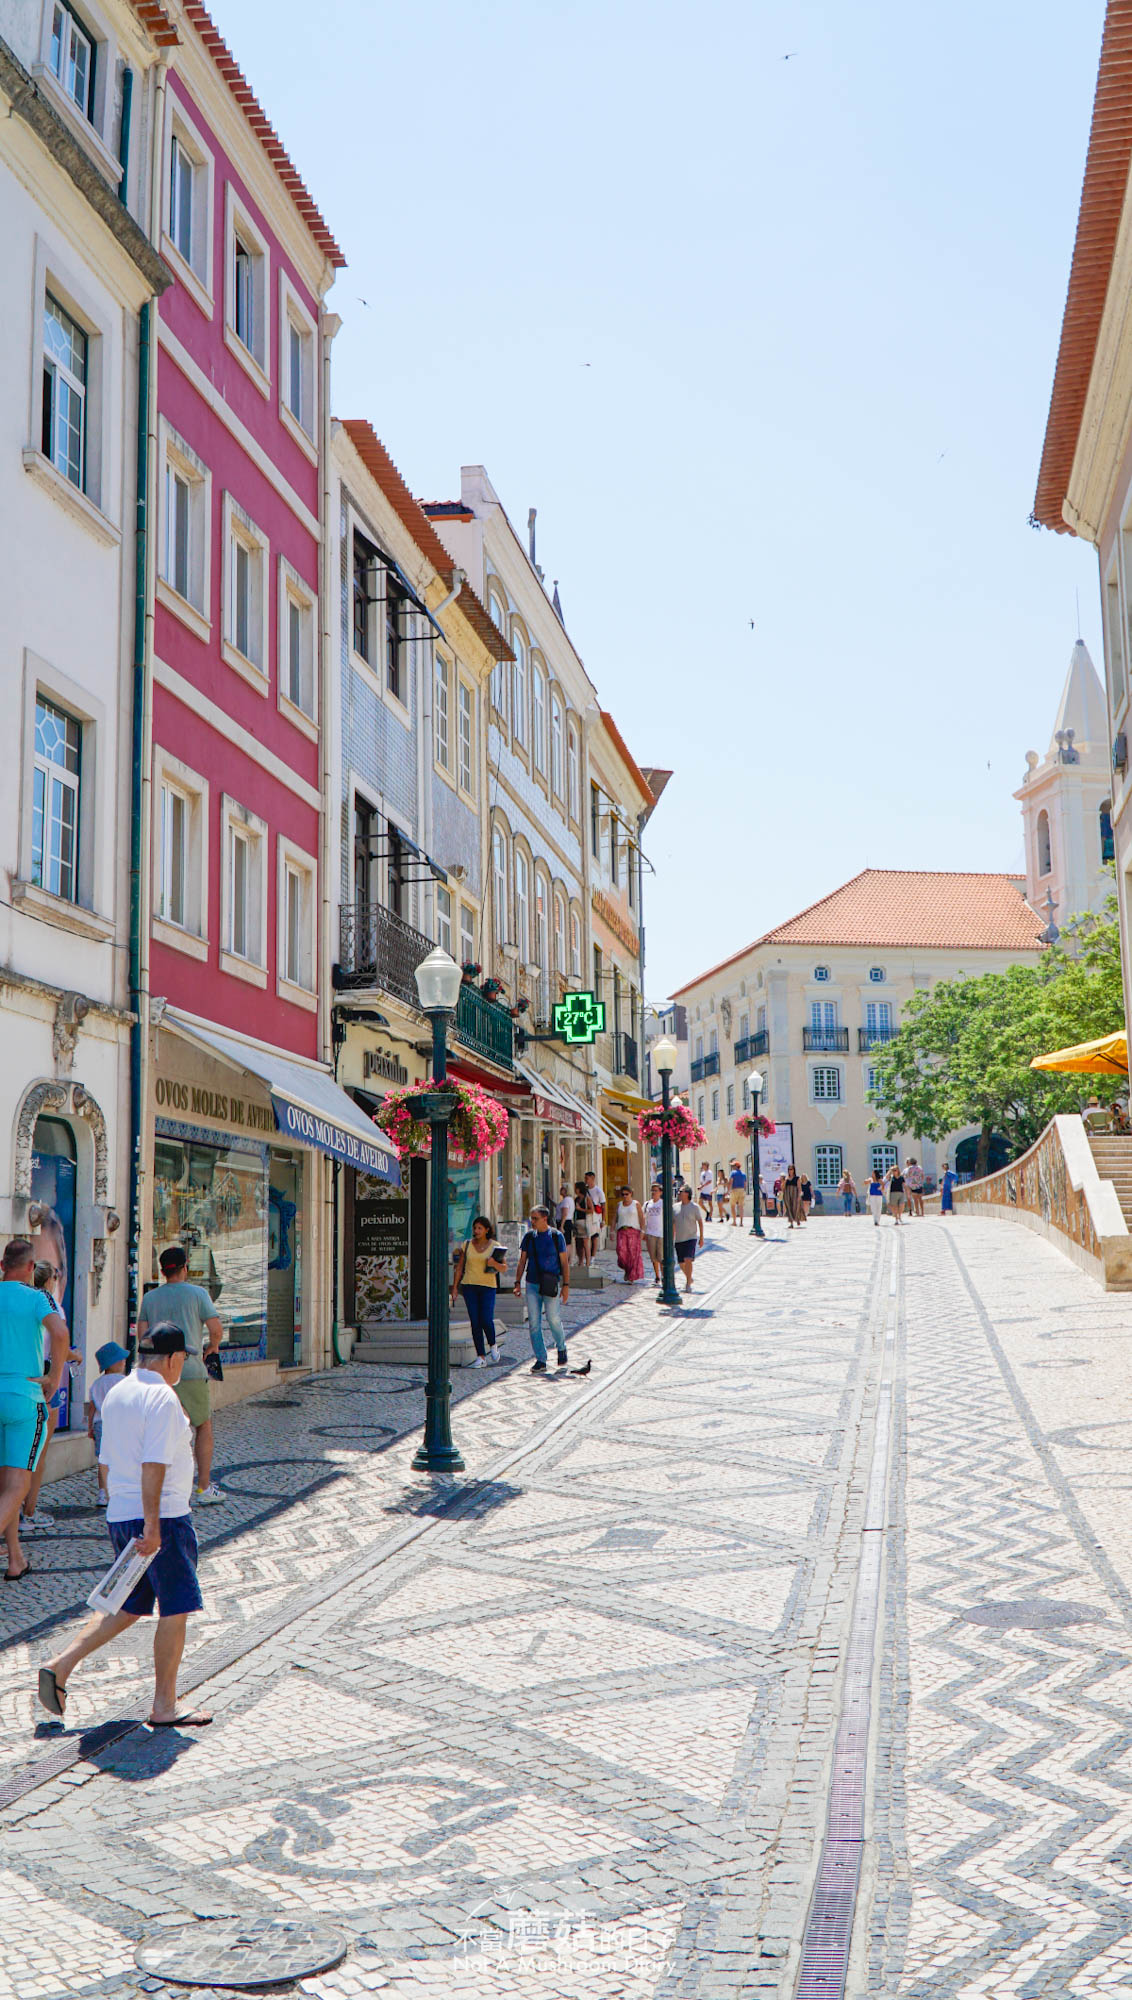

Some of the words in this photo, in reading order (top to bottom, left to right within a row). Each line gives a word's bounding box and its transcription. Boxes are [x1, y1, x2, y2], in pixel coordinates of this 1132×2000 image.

[364, 1046, 408, 1086] peixinho
[155, 1078, 188, 1111] OVOS
[191, 1087, 228, 1121] MOLES
[230, 1097, 244, 1125] DE
[287, 1105, 314, 1138] OVOS
[315, 1118, 346, 1154] MOLES
[347, 1135, 359, 1160] DE
[360, 1143, 389, 1174] AVEIRO
[360, 1213, 406, 1227] peixinho
